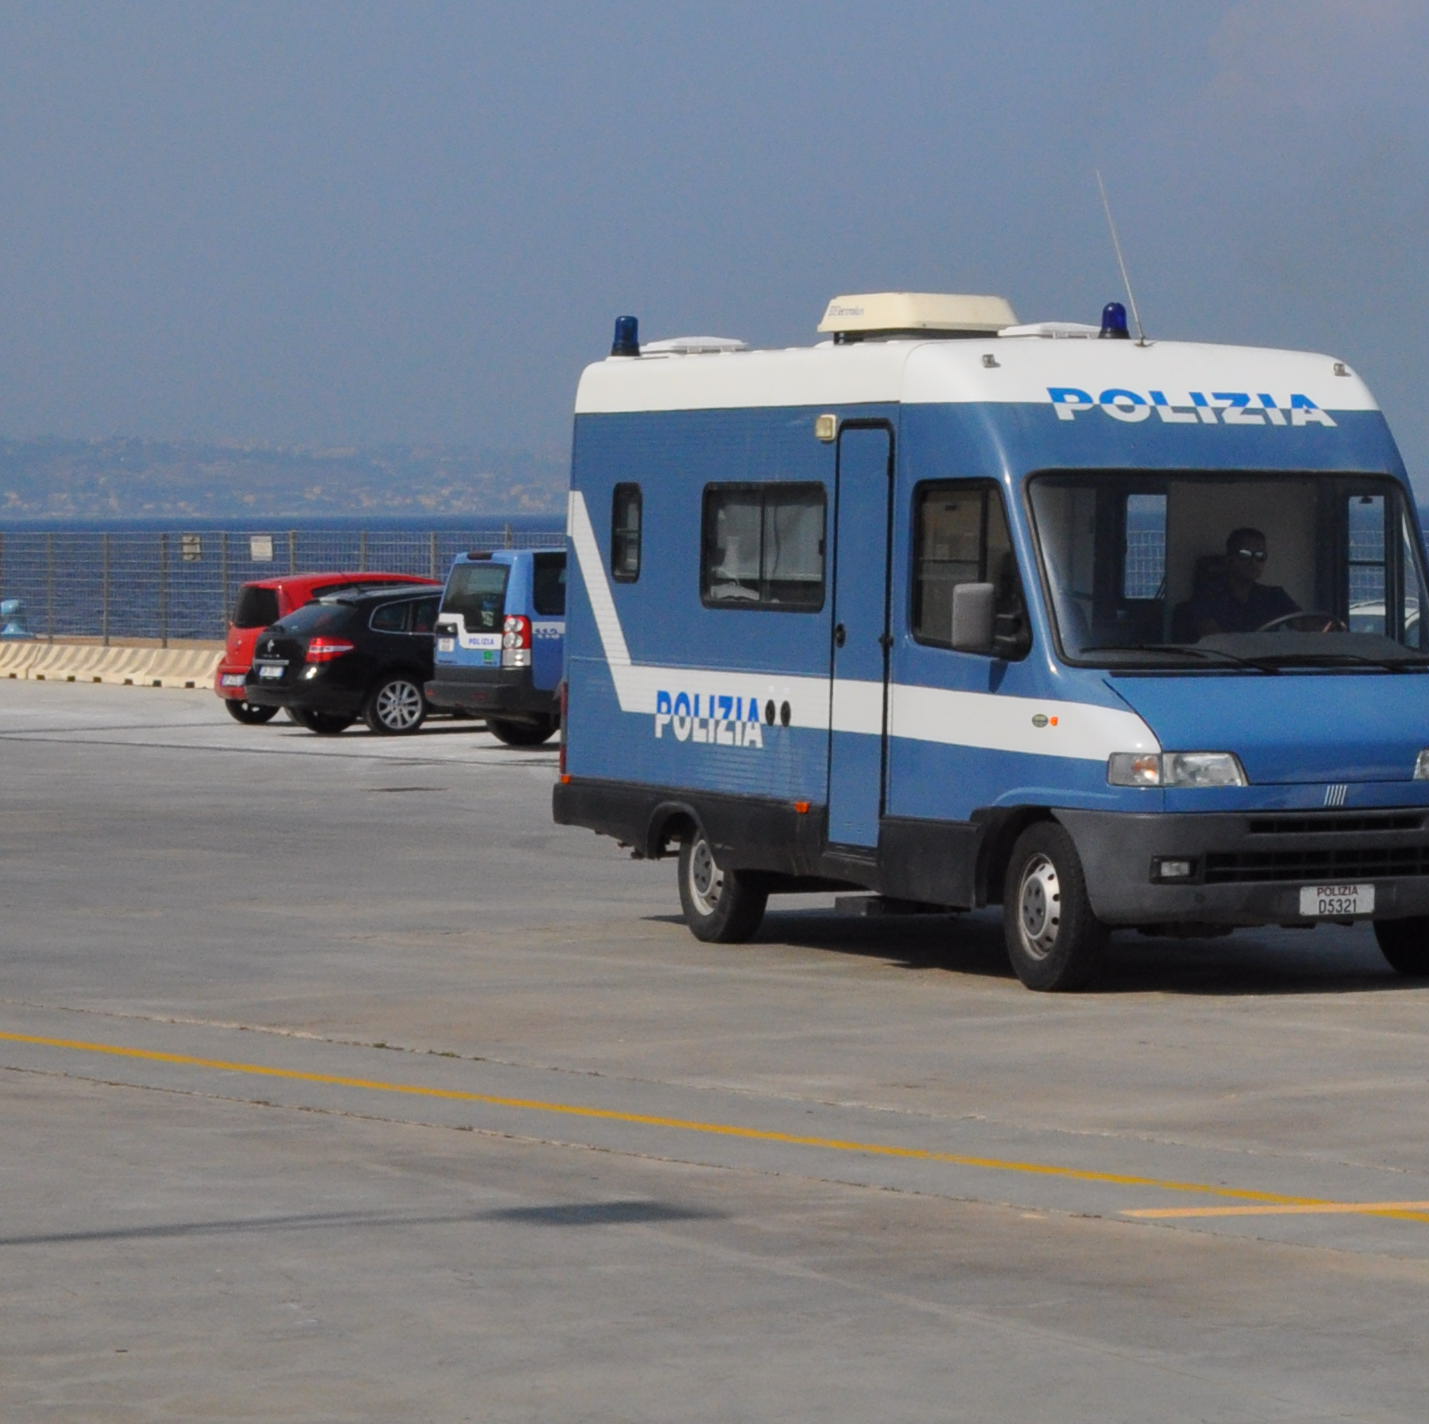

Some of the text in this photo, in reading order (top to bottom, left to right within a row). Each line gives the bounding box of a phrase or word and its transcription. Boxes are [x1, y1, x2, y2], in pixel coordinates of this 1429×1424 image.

[1047, 387, 1338, 427] POLIZIA
[655, 690, 764, 749] POLIZIA
[1317, 886, 1359, 897] POLIZIA
